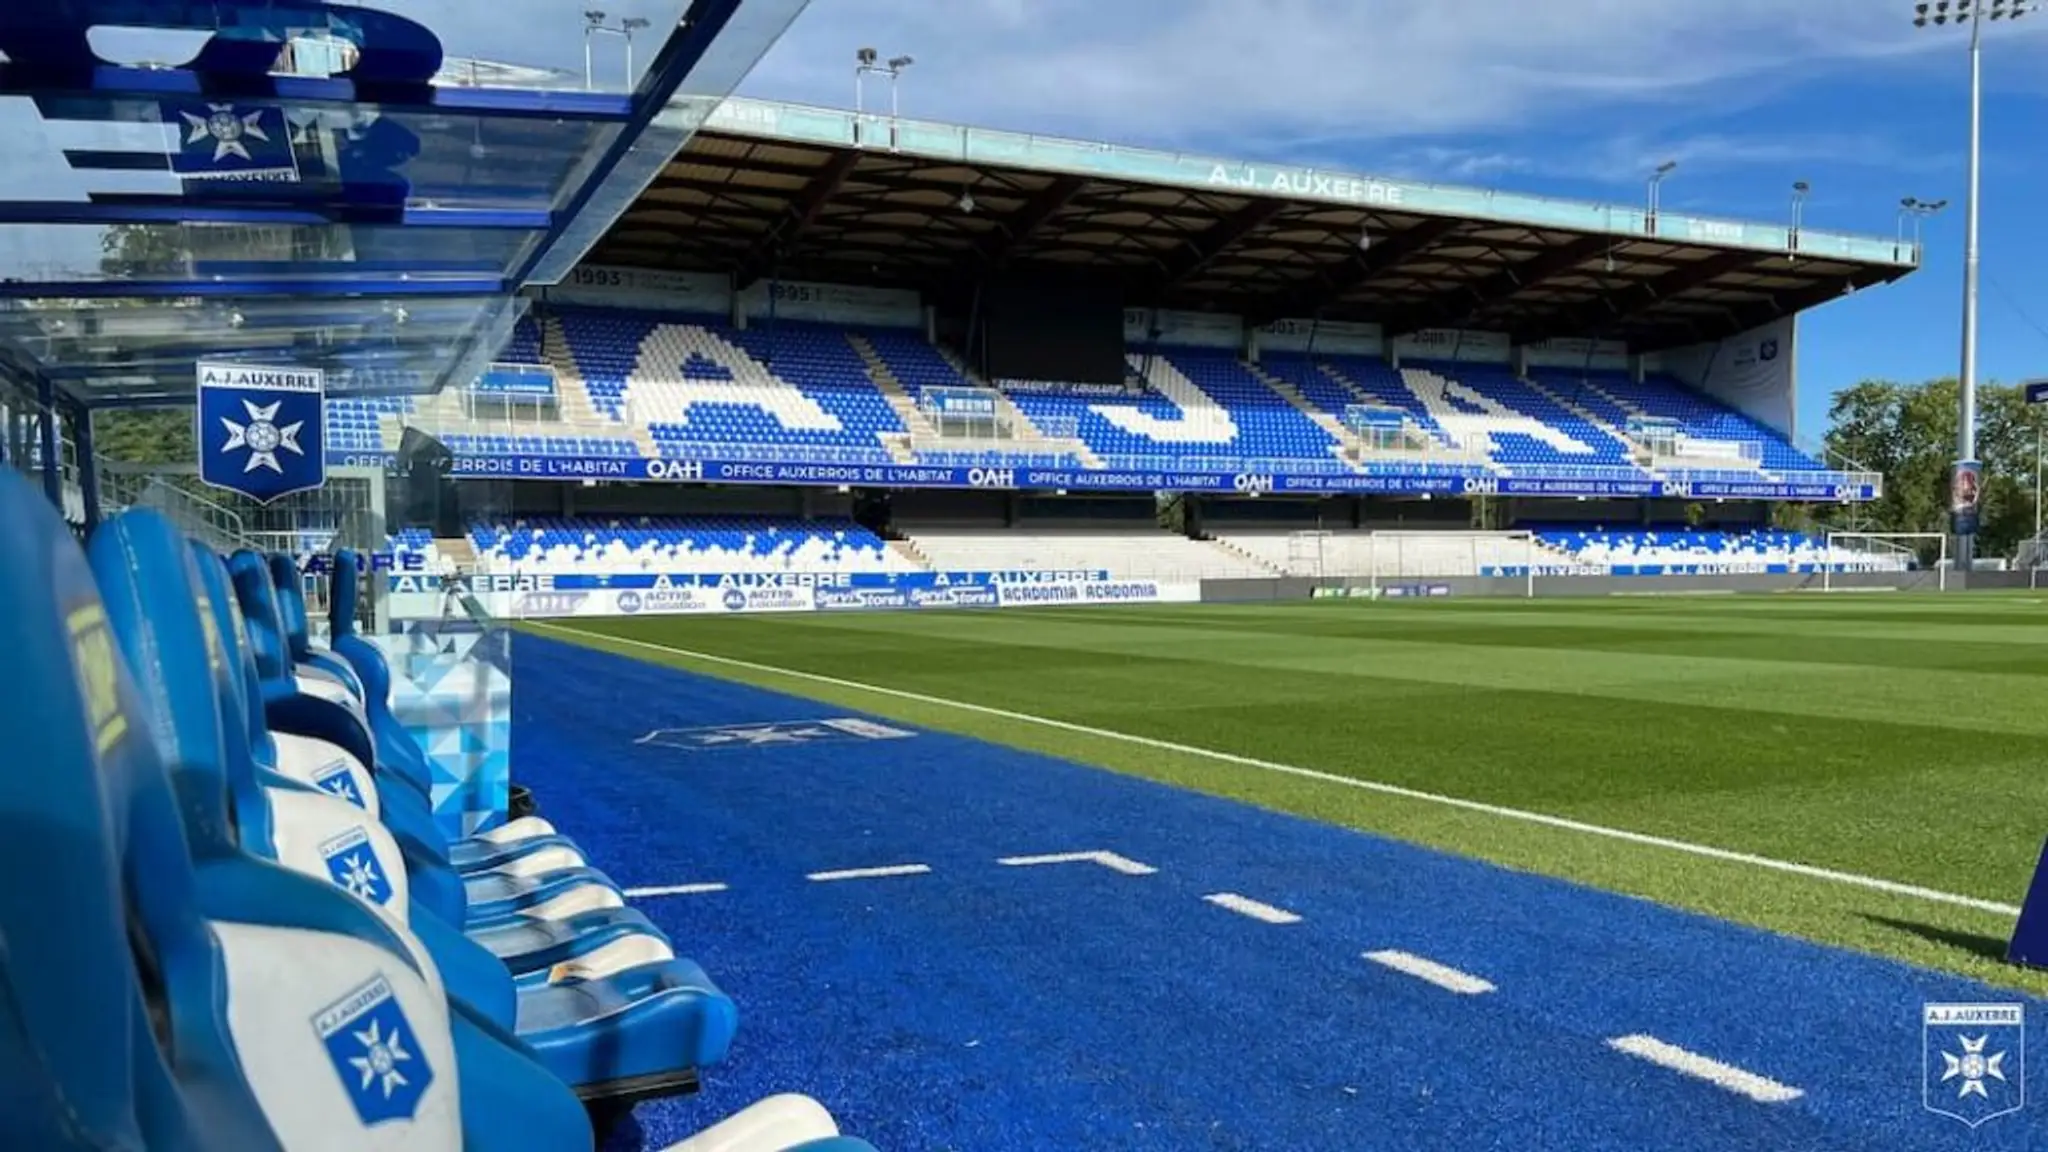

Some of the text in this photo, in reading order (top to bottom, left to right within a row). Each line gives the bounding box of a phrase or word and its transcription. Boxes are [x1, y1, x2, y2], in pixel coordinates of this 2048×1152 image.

[520, 459, 542, 473] DE
[549, 460, 628, 474] L'HABITAT
[646, 460, 702, 479] OAH
[721, 464, 773, 478] OFFICE
[778, 466, 860, 480] AUXERROIS
[864, 468, 883, 480] DE
[888, 469, 953, 481] L'HABITAT
[968, 468, 1014, 486] OAH
[1028, 472, 1071, 485] OFFICE
[1075, 474, 1143, 487] AUXERROIS
[1147, 475, 1162, 487] DE
[1166, 475, 1221, 488] L'HABITAT
[1233, 474, 1274, 491] OAH
[1464, 478, 1498, 493] OAH
[718, 573, 850, 588] AUXERRE
